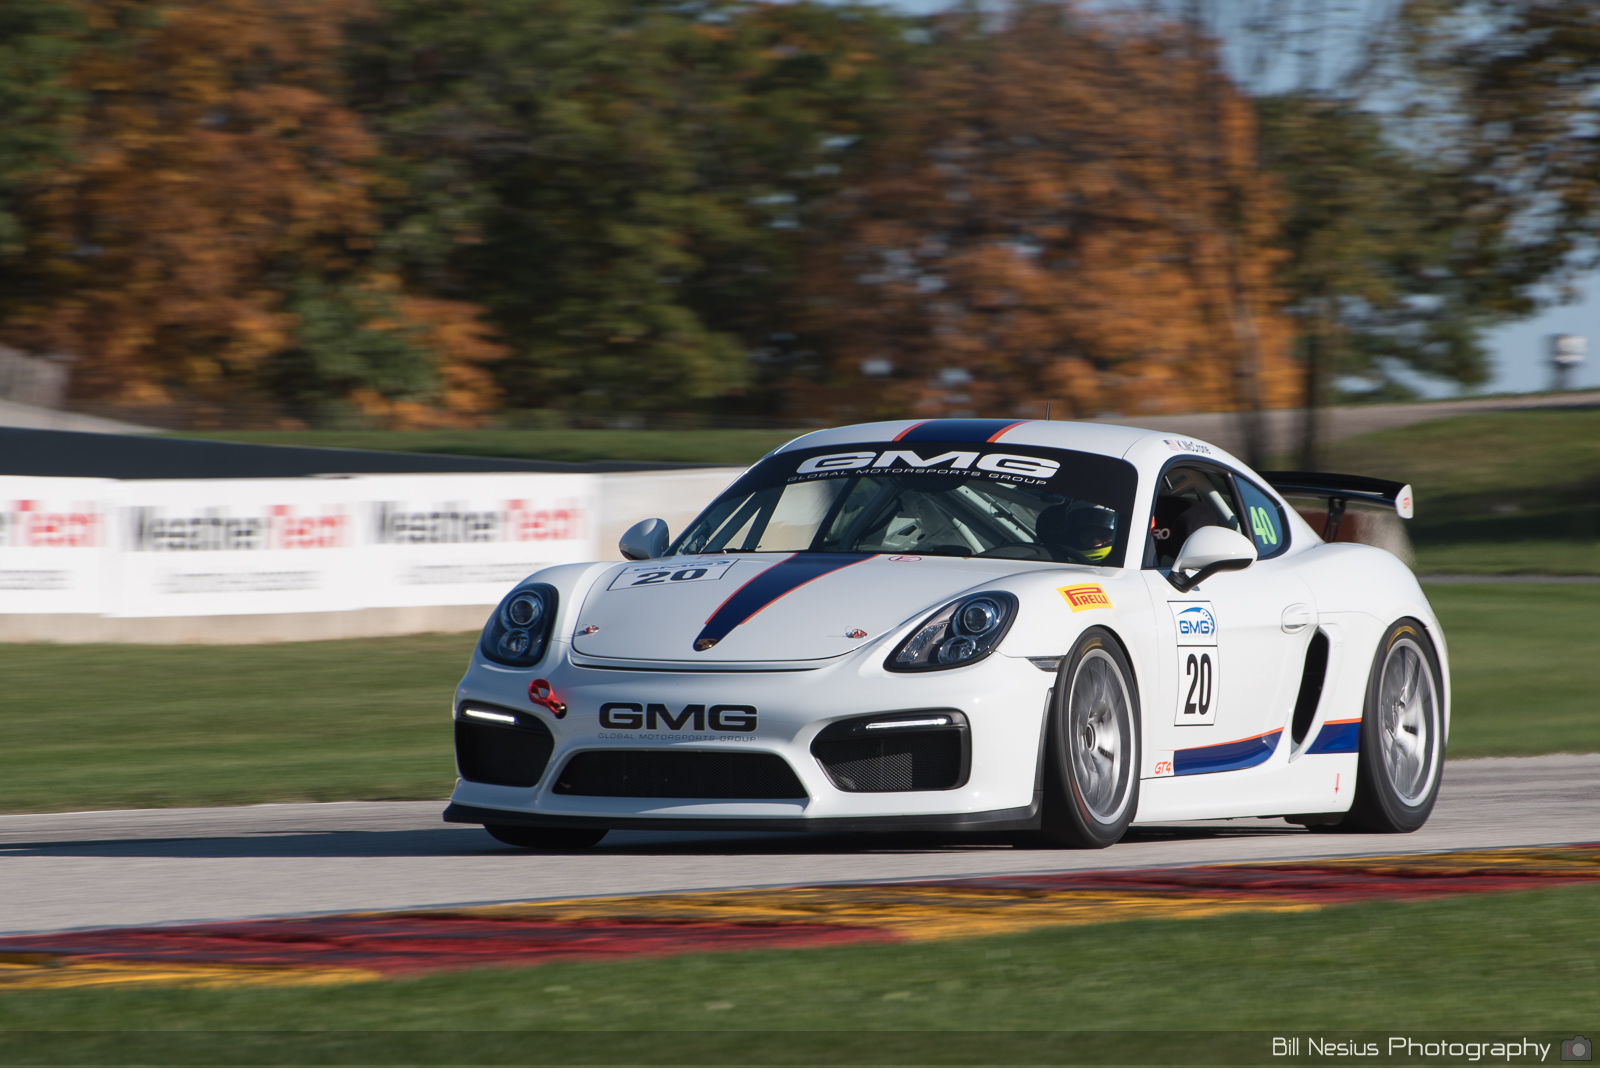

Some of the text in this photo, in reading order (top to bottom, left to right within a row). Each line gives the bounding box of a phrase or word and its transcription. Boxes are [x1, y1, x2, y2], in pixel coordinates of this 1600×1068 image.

[796, 450, 1061, 479] GMG
[787, 467, 1047, 485] GLOBAL MOTORSPORTS GROUP
[1250, 506, 1277, 545] 40
[631, 568, 709, 586] 20
[1064, 587, 1108, 607] PIRELLI
[1179, 620, 1210, 634] GMG
[1184, 653, 1212, 715] 20
[599, 702, 758, 732] GMG
[639, 733, 715, 741] MOTORSPORTS
